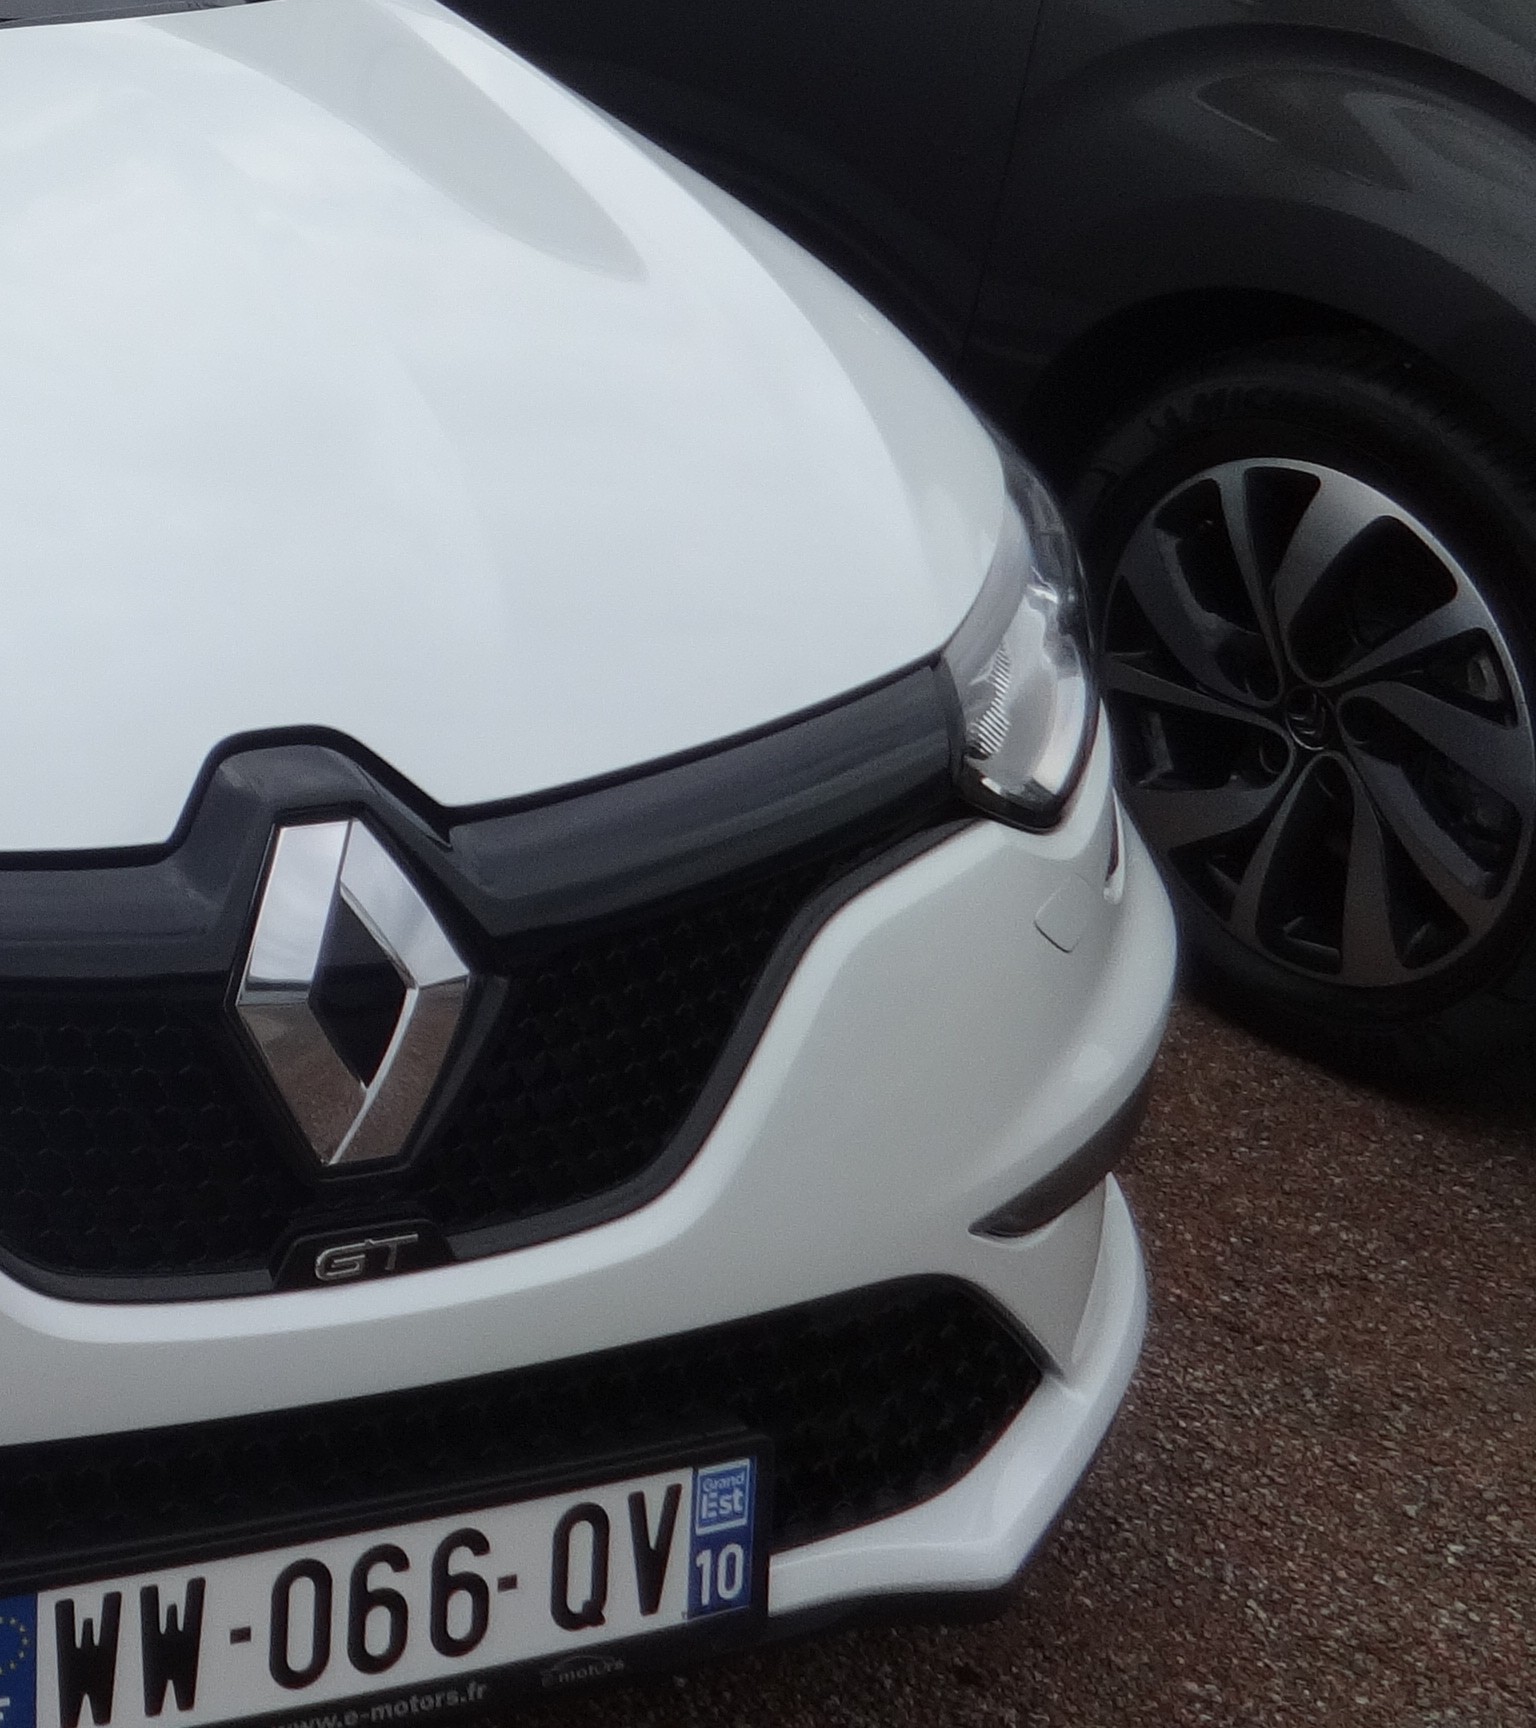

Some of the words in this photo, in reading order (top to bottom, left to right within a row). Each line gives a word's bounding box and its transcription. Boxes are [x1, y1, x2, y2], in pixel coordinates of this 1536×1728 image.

[315, 1233, 419, 1281] GT
[701, 1487, 744, 1520] Est
[702, 1474, 745, 1492] Grand
[696, 1543, 744, 1606] 10
[55, 1482, 684, 1728] WW-066-QV
[278, 1680, 487, 1728] ww.e-motors.fr
